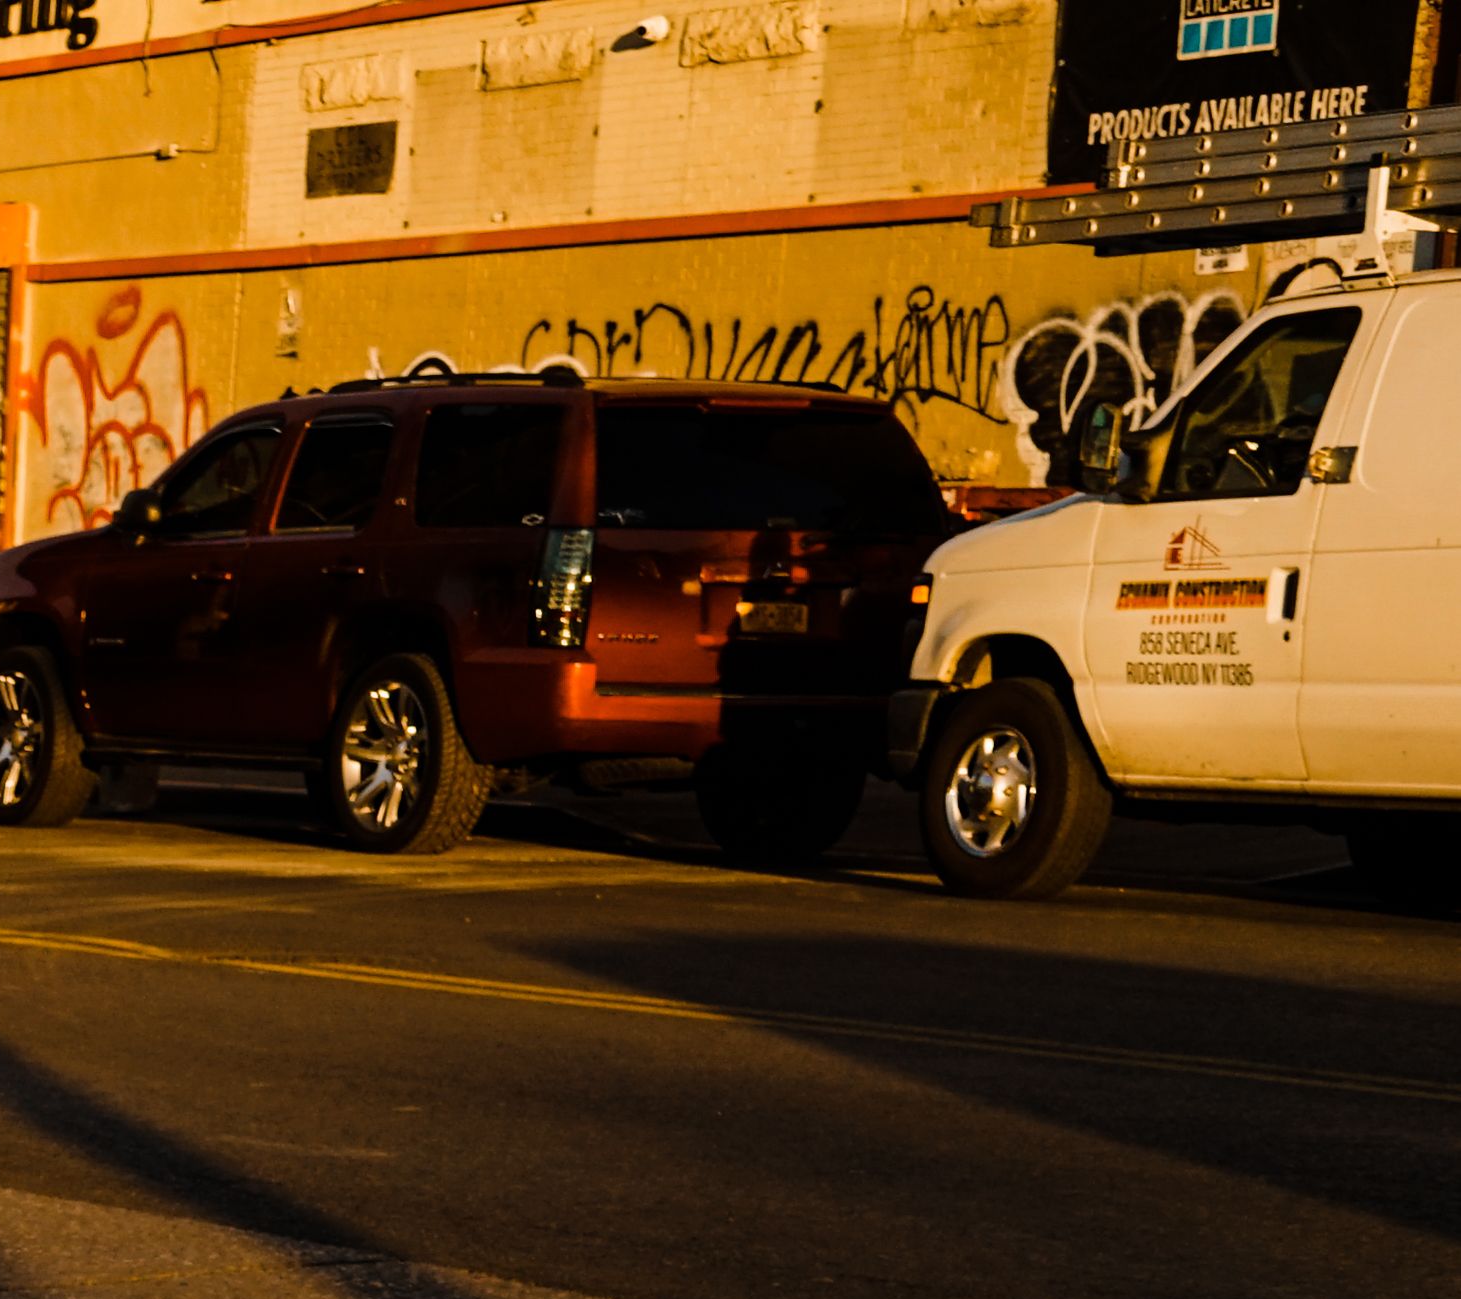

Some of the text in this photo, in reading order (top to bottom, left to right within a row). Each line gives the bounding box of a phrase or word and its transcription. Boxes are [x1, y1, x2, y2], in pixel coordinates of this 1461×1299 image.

[1087, 84, 1369, 146] PRODUCTS AVAILABLE HERE
[1174, 578, 1268, 609] CONSTRUCTION
[1151, 613, 1226, 625] CORPORATION
[1140, 631, 1164, 656] 858
[1166, 631, 1213, 656] SENECA
[1126, 662, 1255, 687] RIDGEWOOD NY 11385
